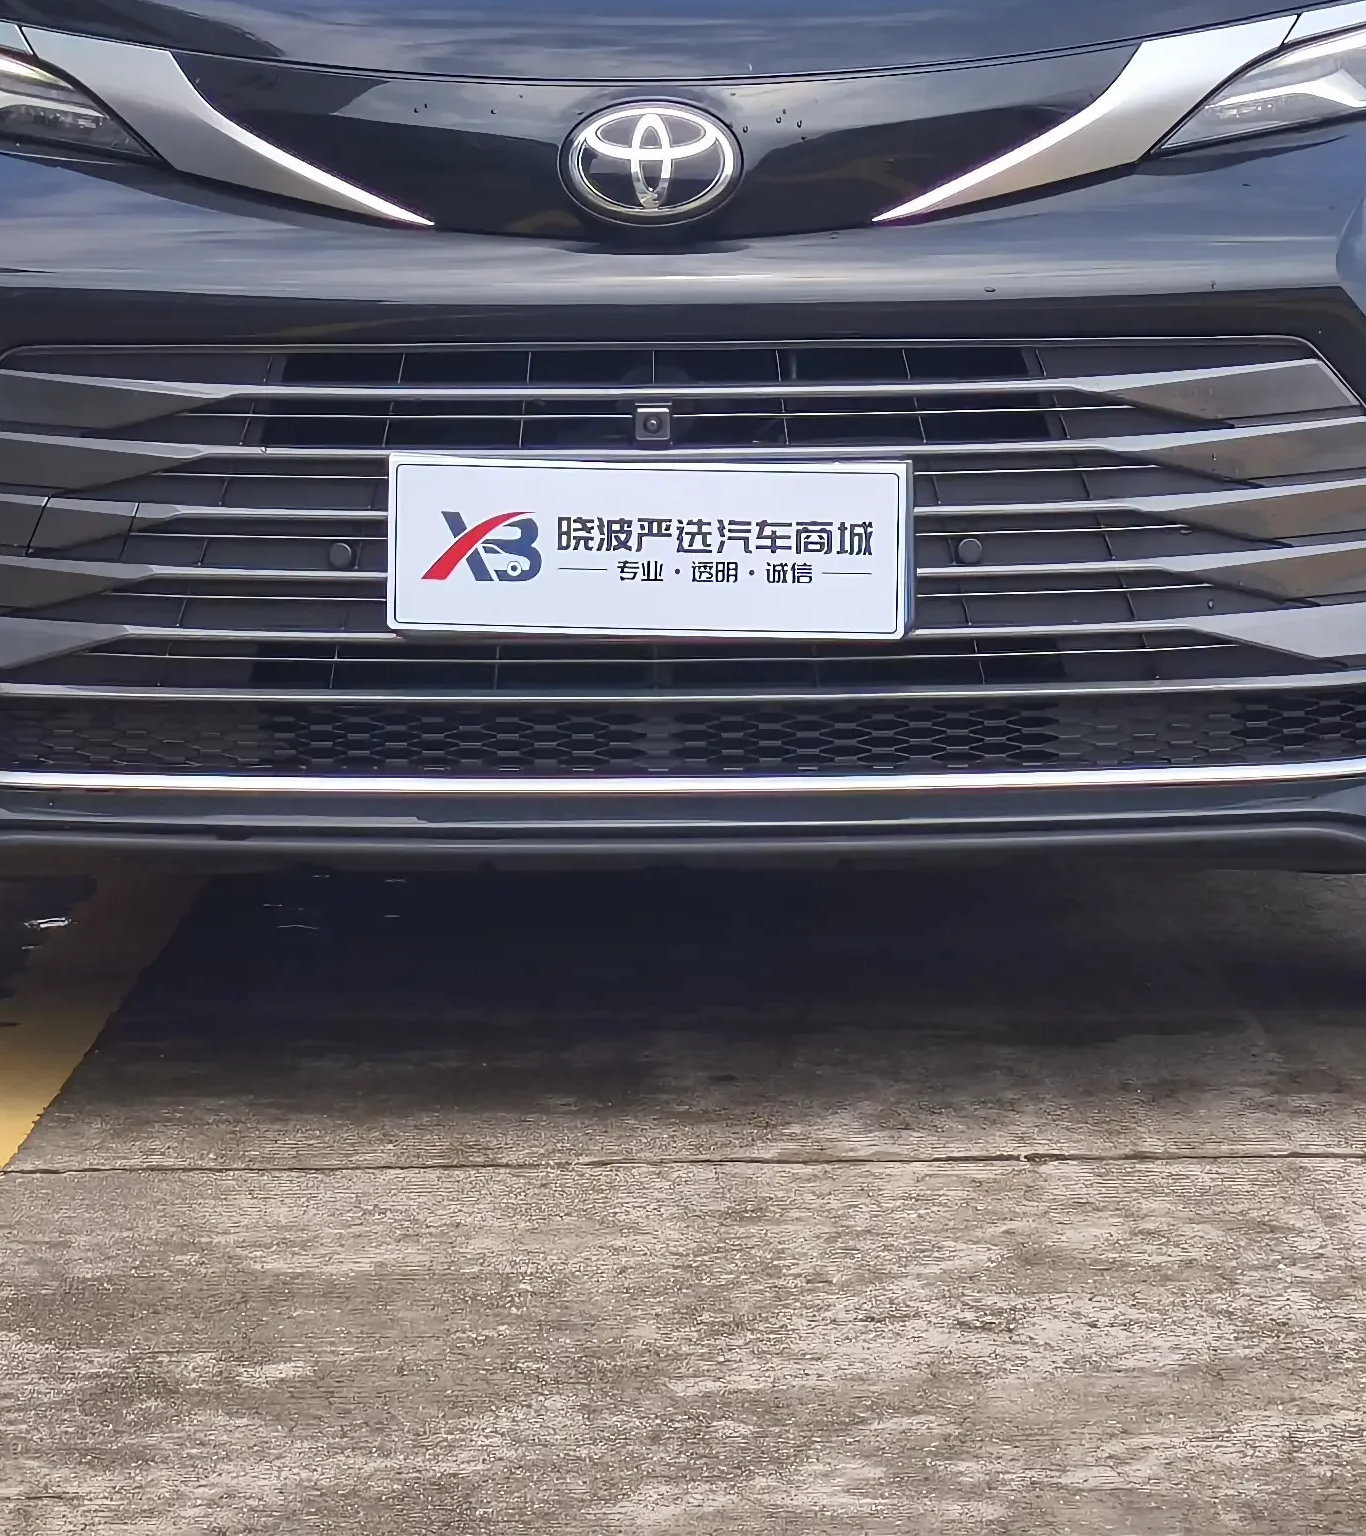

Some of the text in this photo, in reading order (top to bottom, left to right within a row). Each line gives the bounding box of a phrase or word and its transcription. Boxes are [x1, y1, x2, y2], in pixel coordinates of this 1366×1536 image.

[556, 516, 874, 556] 晓波严选汽车商城
